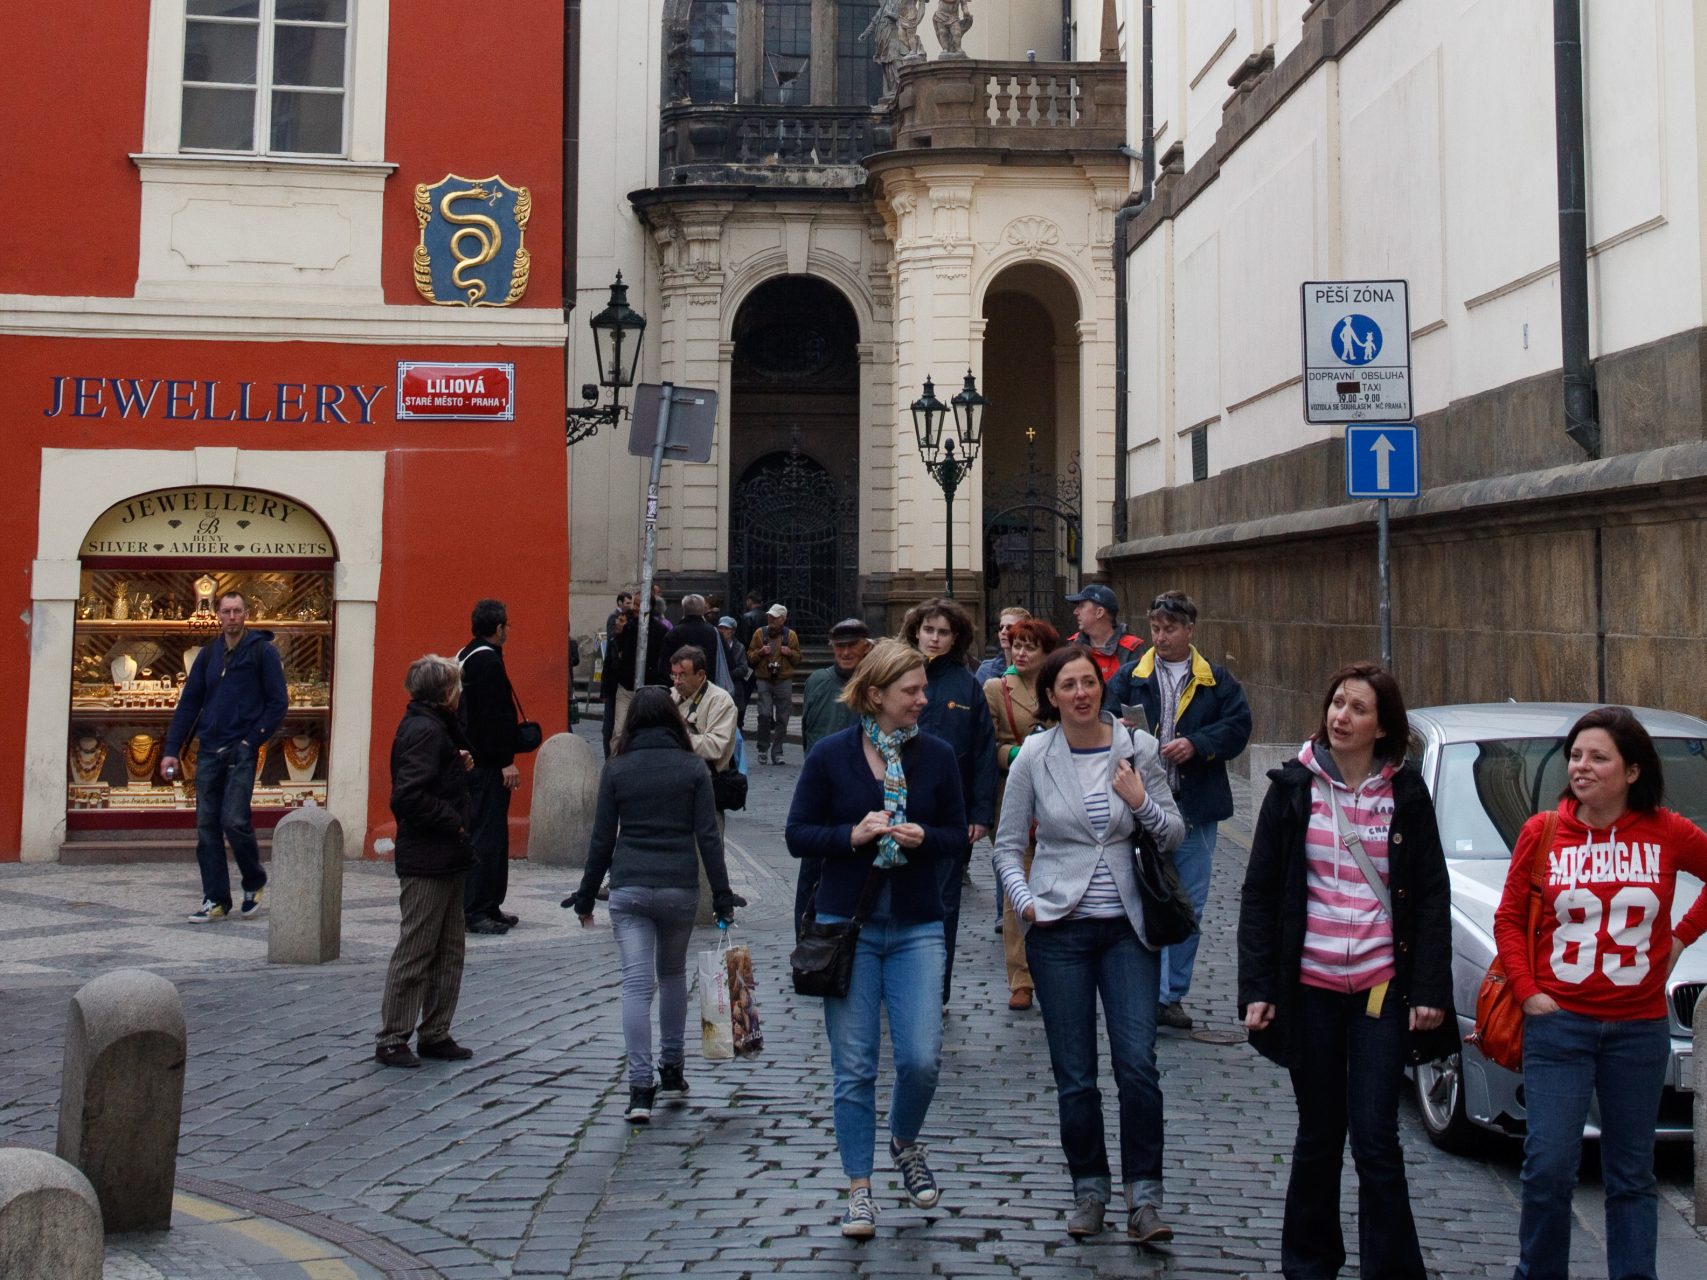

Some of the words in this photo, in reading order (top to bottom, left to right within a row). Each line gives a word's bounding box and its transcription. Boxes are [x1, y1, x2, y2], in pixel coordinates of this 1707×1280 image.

[1316, 286, 1349, 303] PĚŠÍ
[1353, 285, 1395, 303] ZÓNA
[1309, 369, 1356, 381] DOPRAVNÍ
[1361, 371, 1404, 380] OBSLUHA
[427, 376, 486, 394] LILIOVÁ
[1362, 383, 1381, 392] TAXI
[43, 376, 387, 424] JEWELLERY
[405, 395, 432, 406] STARÉ
[434, 395, 463, 406] MĚSTO
[471, 397, 499, 406] PRAHA
[502, 398, 506, 406] 1
[1339, 394, 1357, 403] 19.00
[1364, 393, 1381, 402] 9.00
[1311, 403, 1332, 411] VOZIDLA
[1385, 402, 1402, 410] PRAHA
[122, 492, 298, 524] JEWELLERY
[88, 541, 149, 553] SILVER
[169, 542, 229, 554] AMBER
[250, 543, 327, 555] GARNETS
[1549, 841, 1661, 886] MICHIGAN
[1549, 886, 1660, 986] 89
